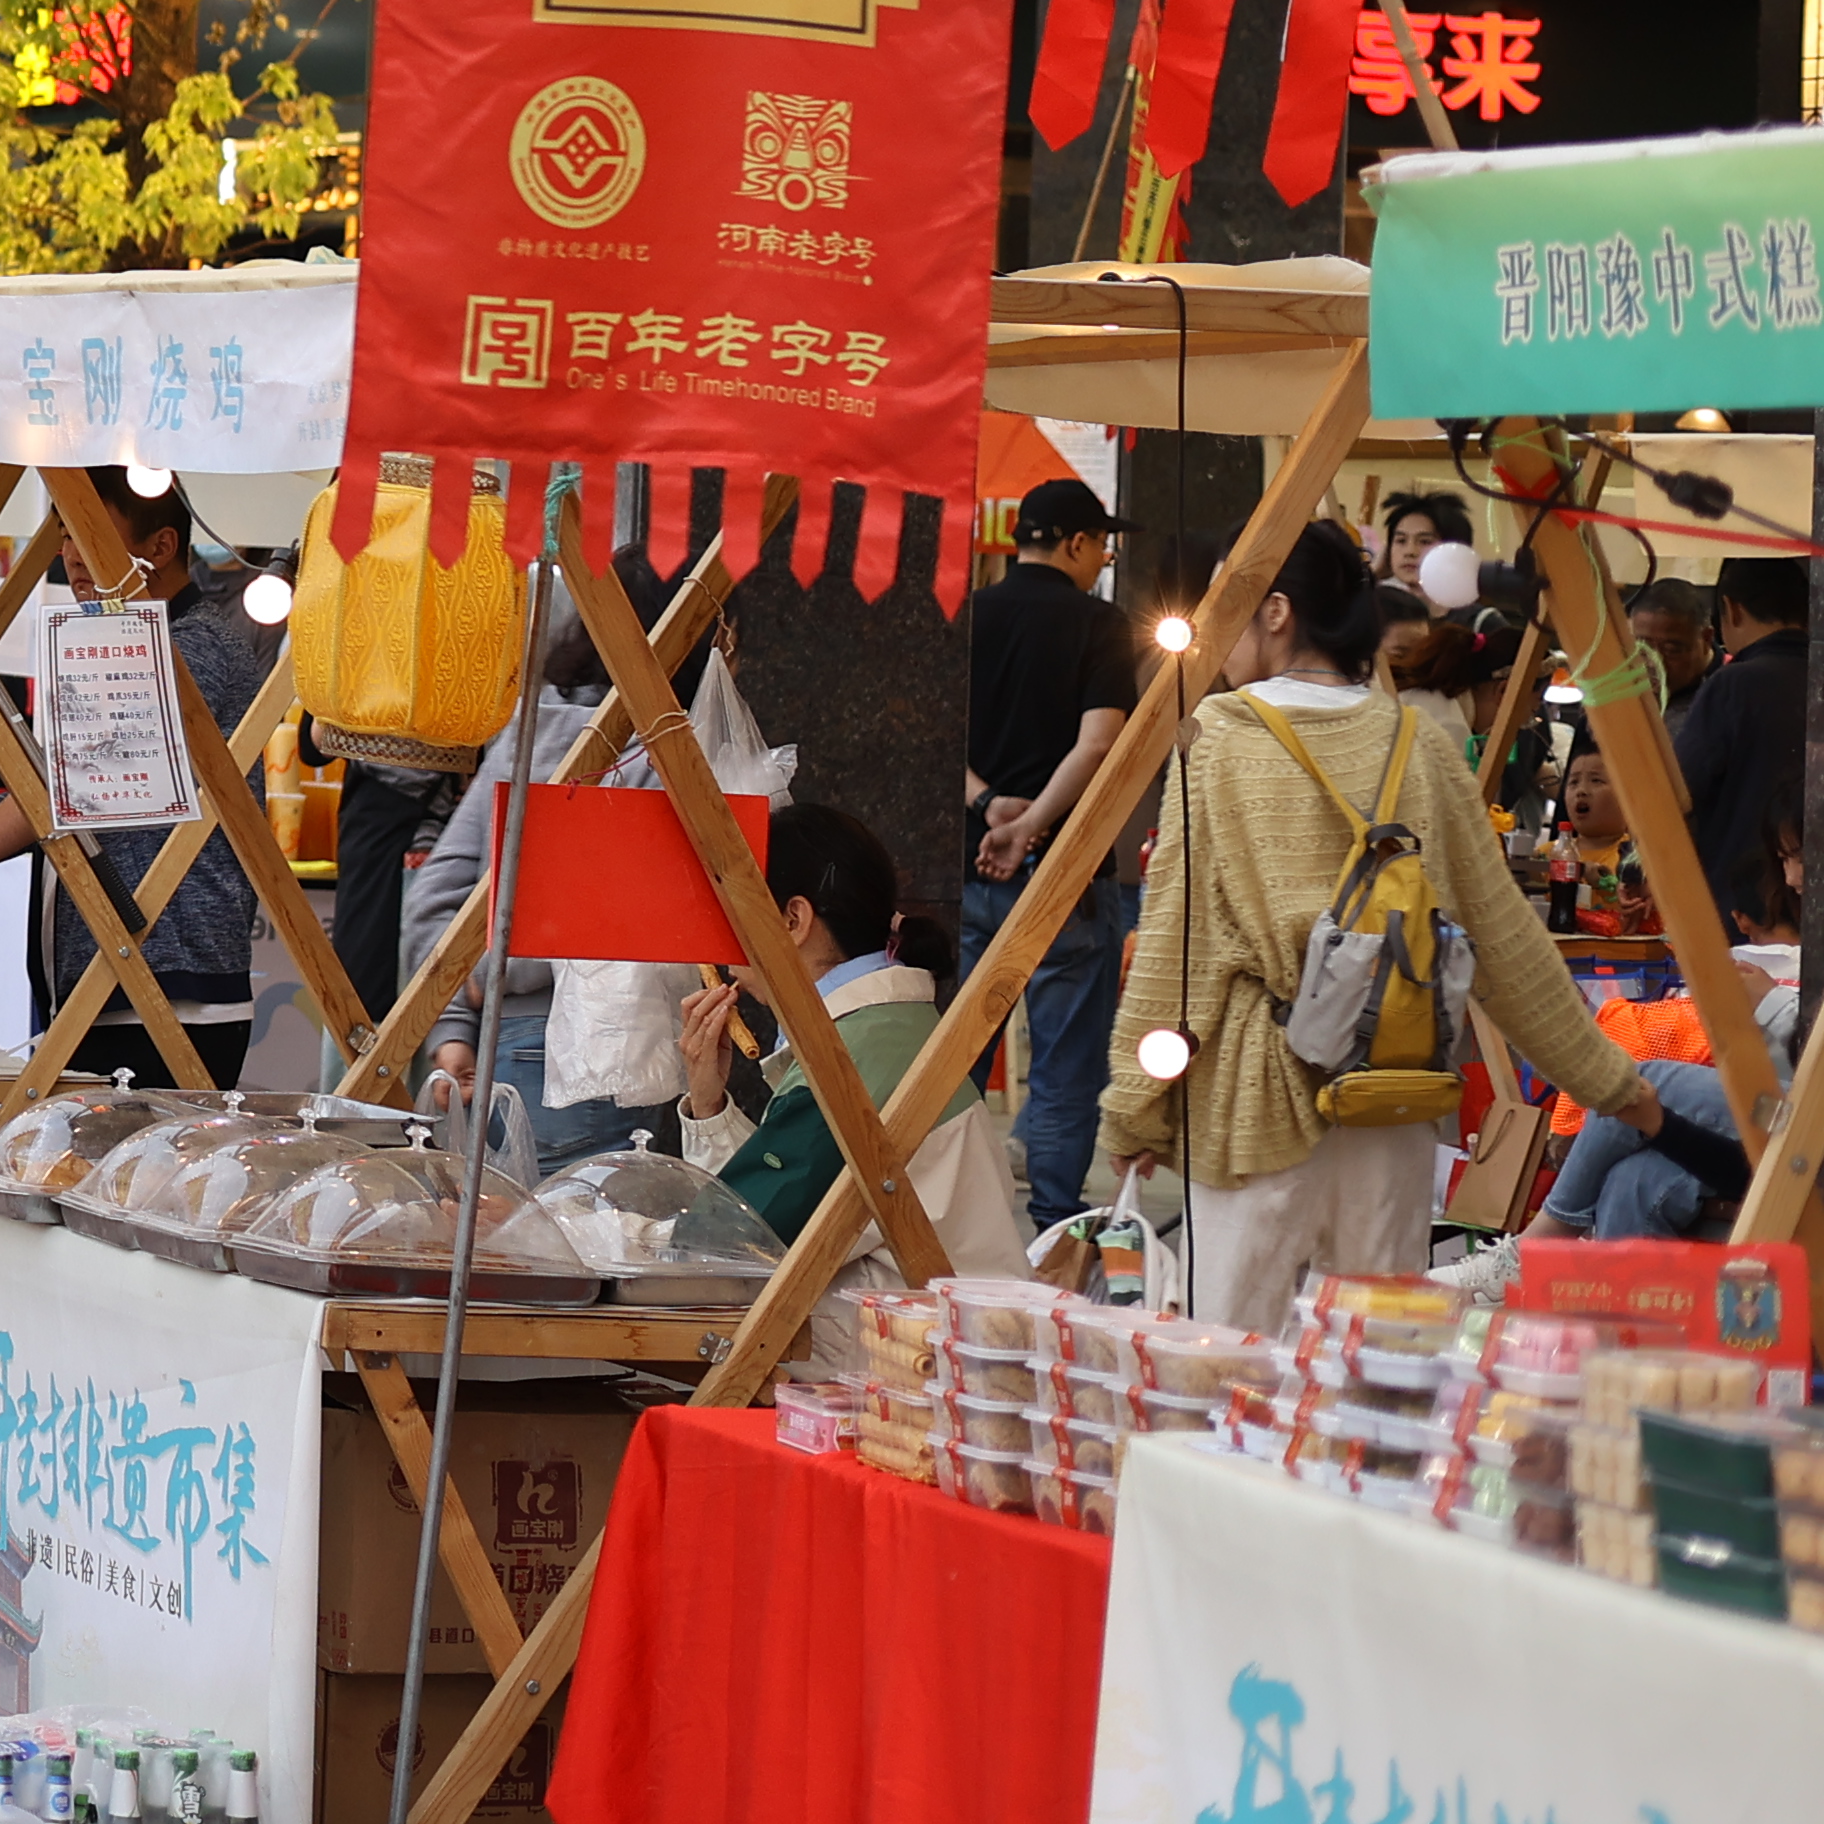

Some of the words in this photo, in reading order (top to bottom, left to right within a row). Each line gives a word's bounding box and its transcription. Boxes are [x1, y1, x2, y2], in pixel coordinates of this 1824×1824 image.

[716, 222, 878, 270] 河南老字号
[1495, 219, 1822, 344] 晋阳豫中式糕
[565, 307, 891, 387] 百年老字号
[638, 370, 679, 394] Life
[683, 372, 821, 409] Timehonored
[825, 388, 877, 419] Brand
[63, 644, 148, 661] 画宝刚道口烧鸡
[510, 1518, 565, 1540] 画宝刚
